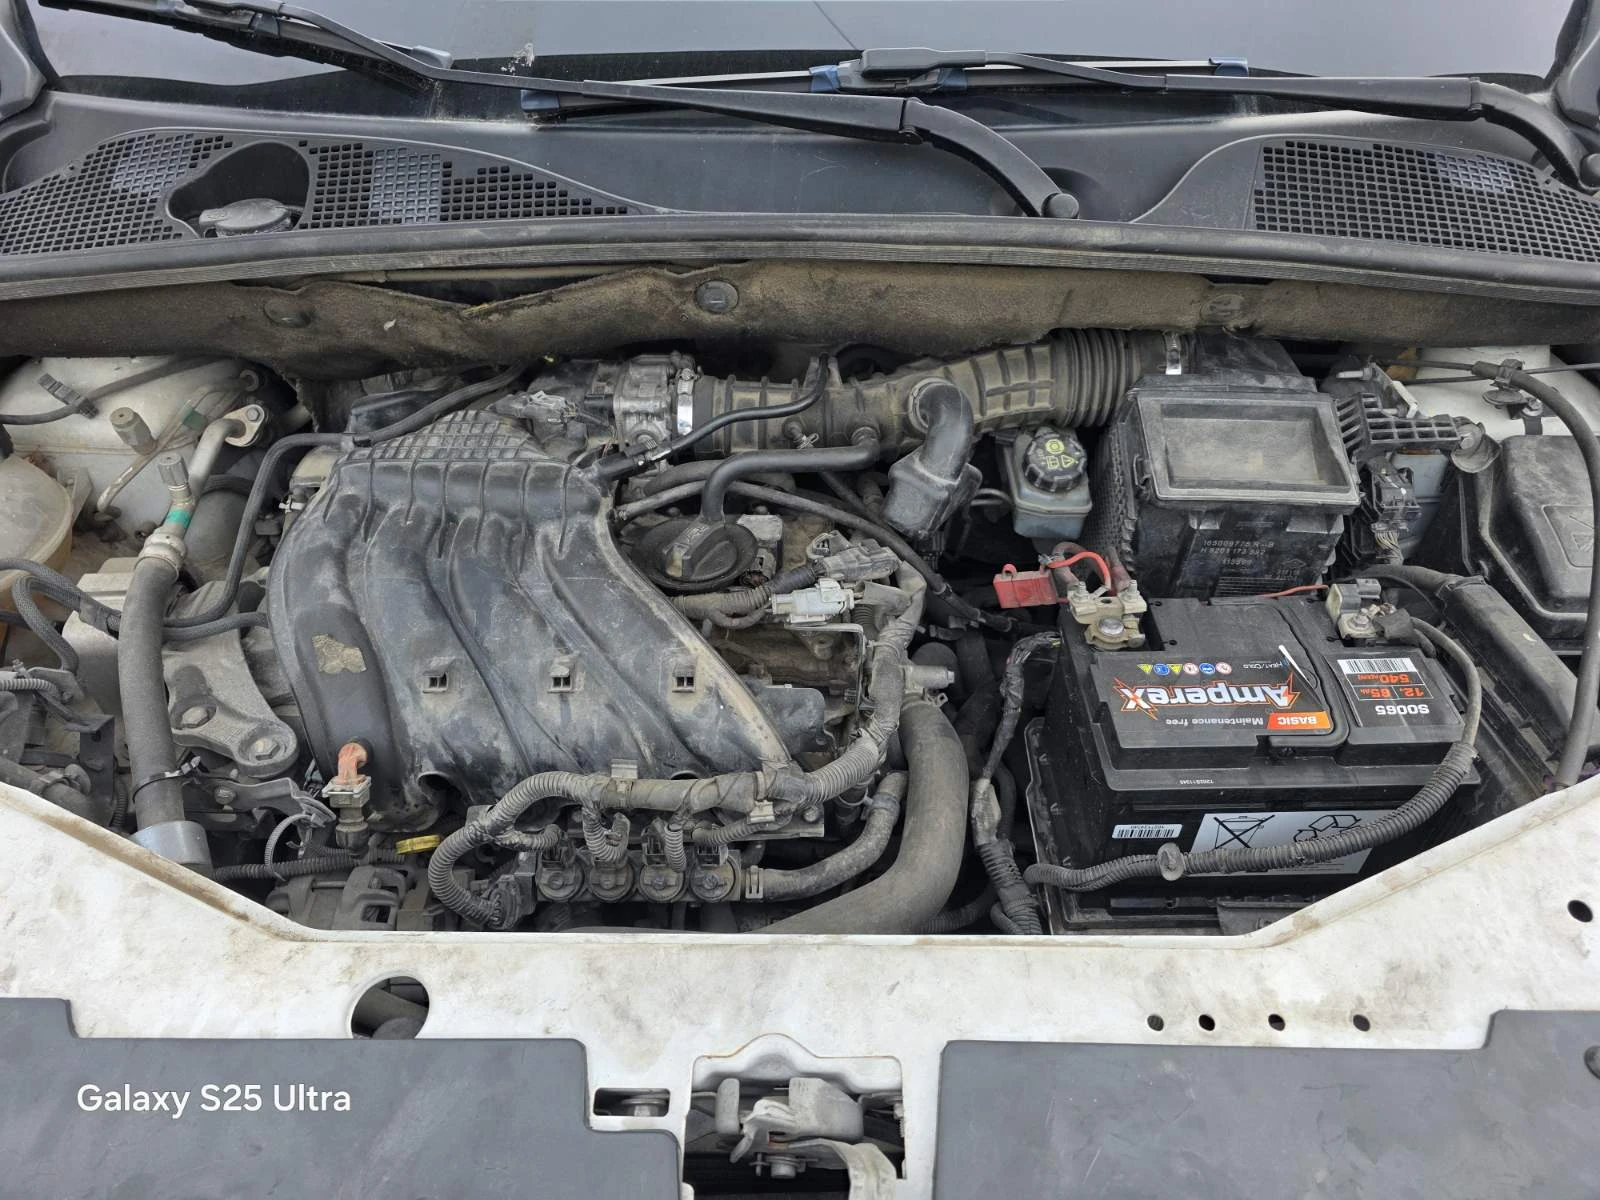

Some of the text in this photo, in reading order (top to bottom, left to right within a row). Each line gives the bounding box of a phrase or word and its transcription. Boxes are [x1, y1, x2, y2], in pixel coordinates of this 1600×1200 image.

[1165, 715, 1318, 727] BASIC Maintenance free
